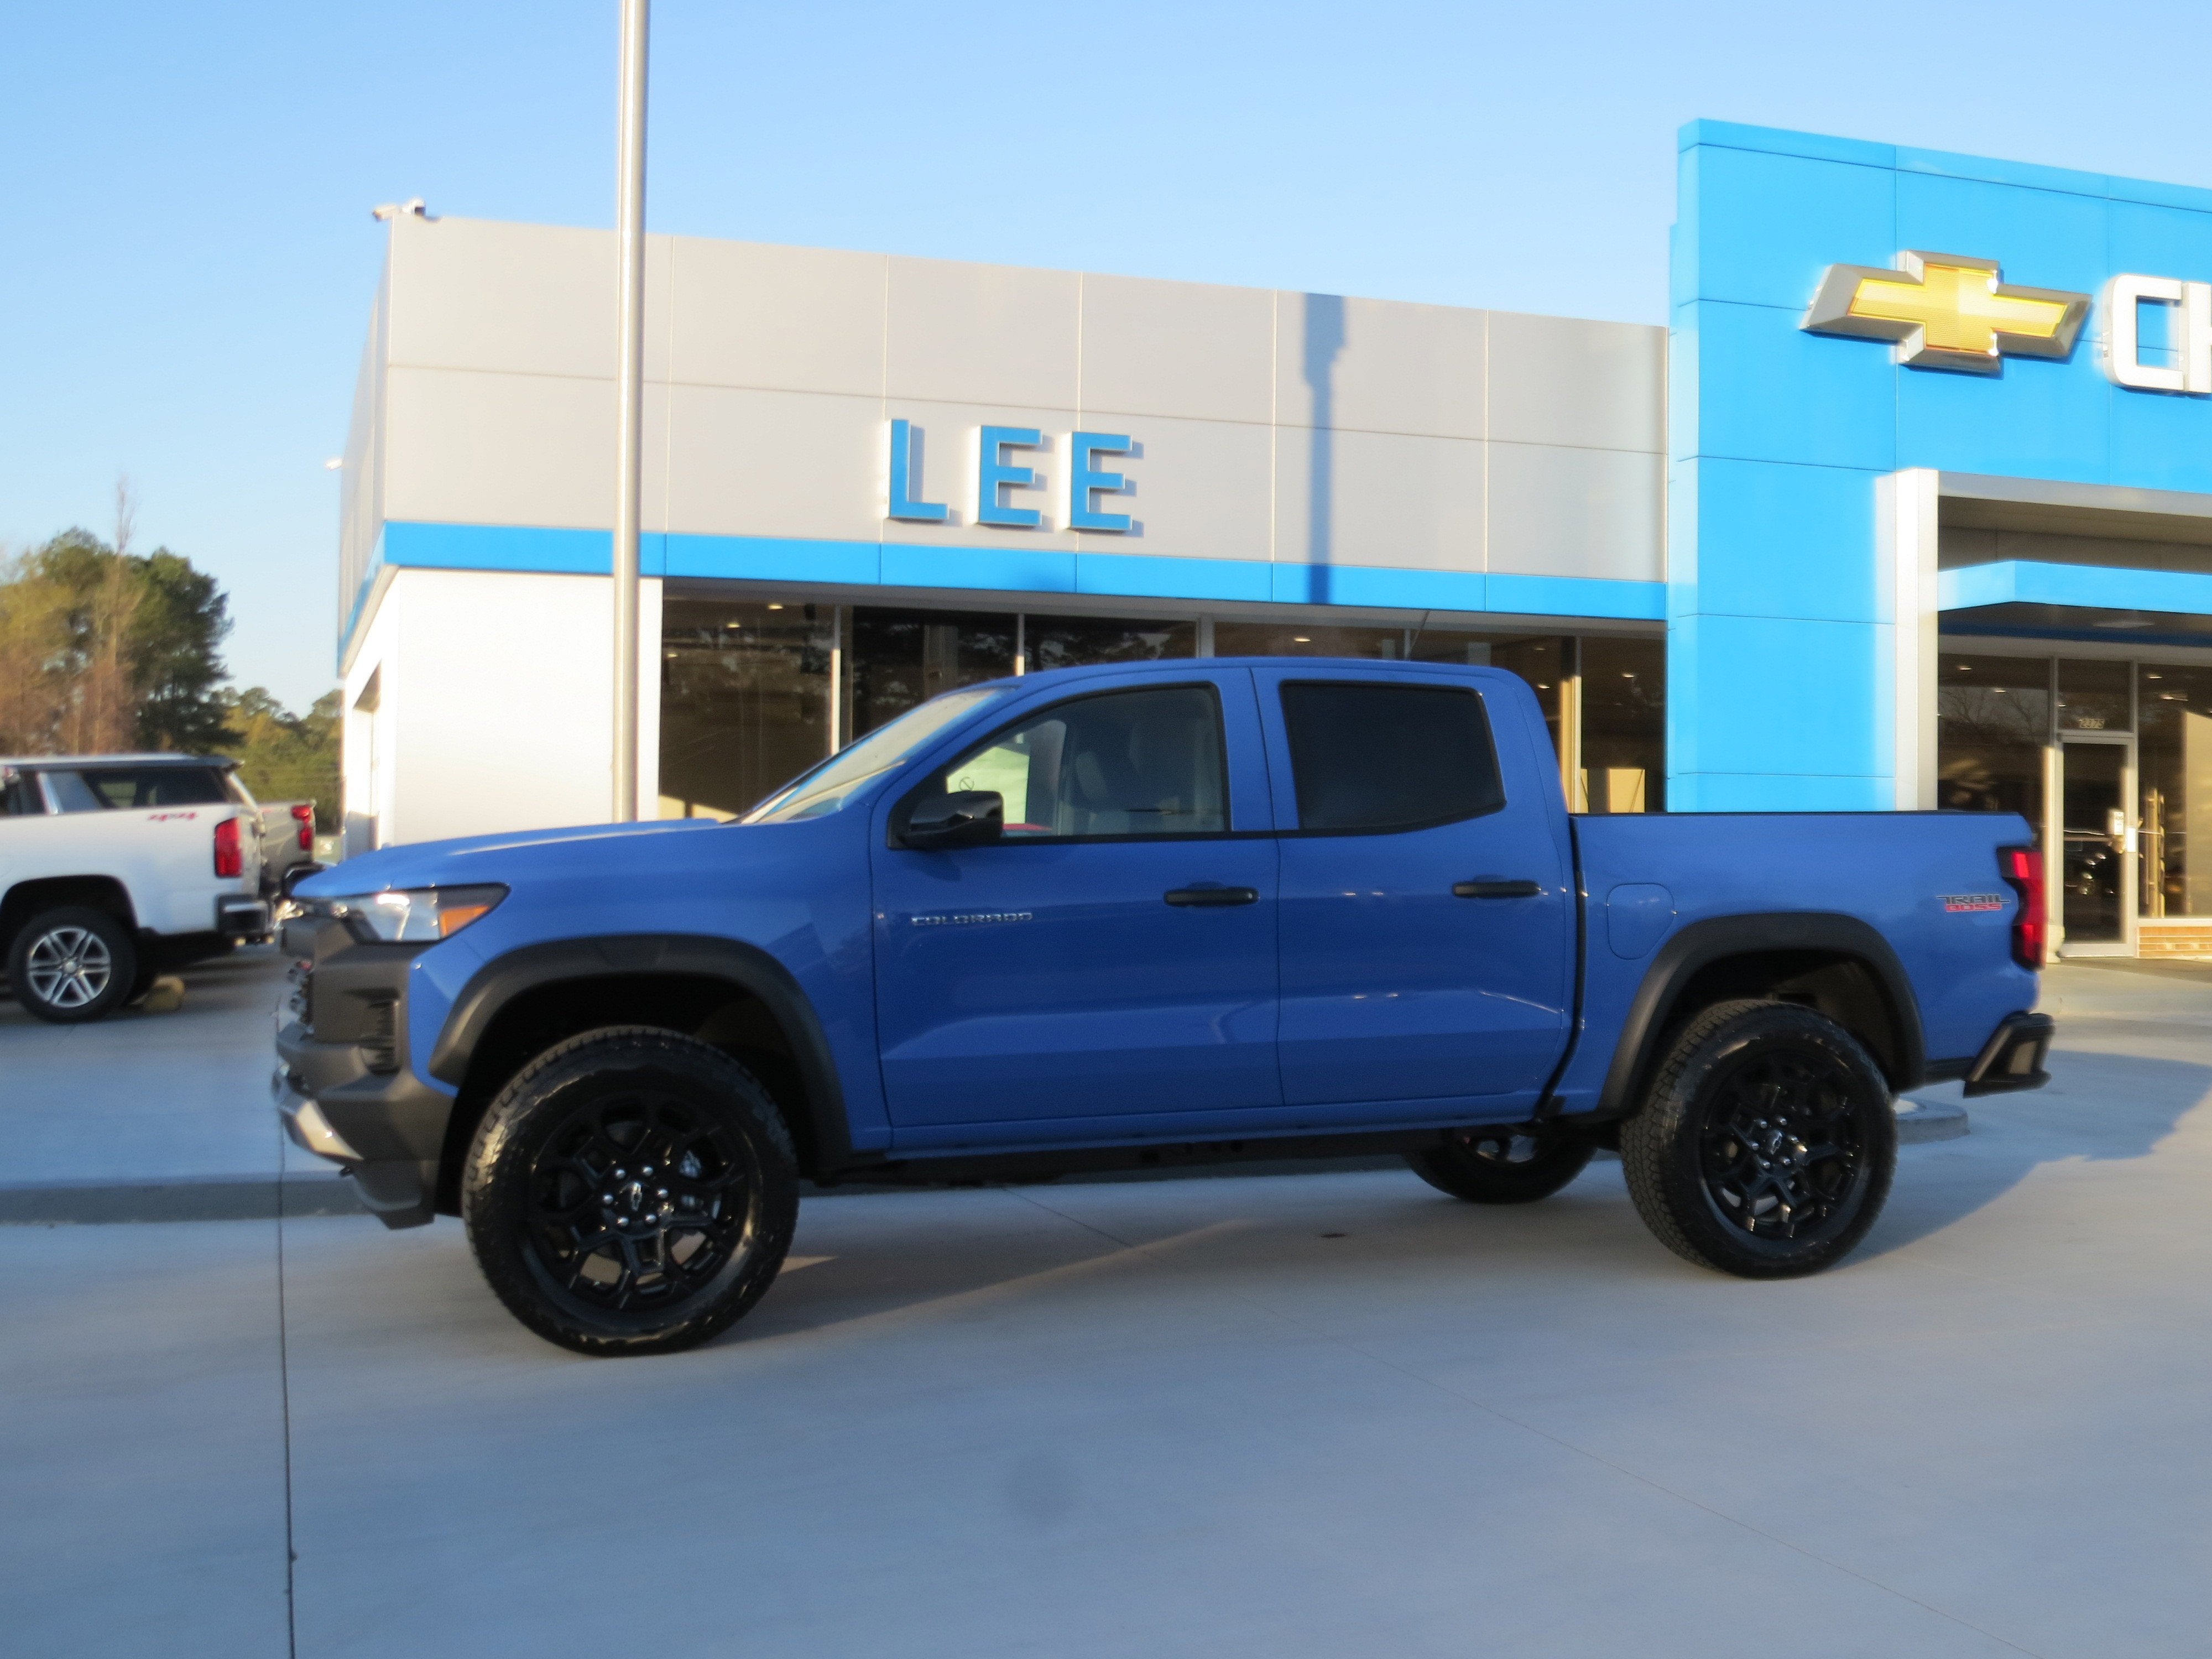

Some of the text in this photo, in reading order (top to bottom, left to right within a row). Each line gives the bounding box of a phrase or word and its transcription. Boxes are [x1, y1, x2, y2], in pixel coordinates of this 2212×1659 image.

[887, 419, 1133, 531] LEE
[1936, 894, 2010, 904] TRAIL
[1945, 904, 2002, 912] BOSS
[911, 912, 1033, 926] COLORADO
